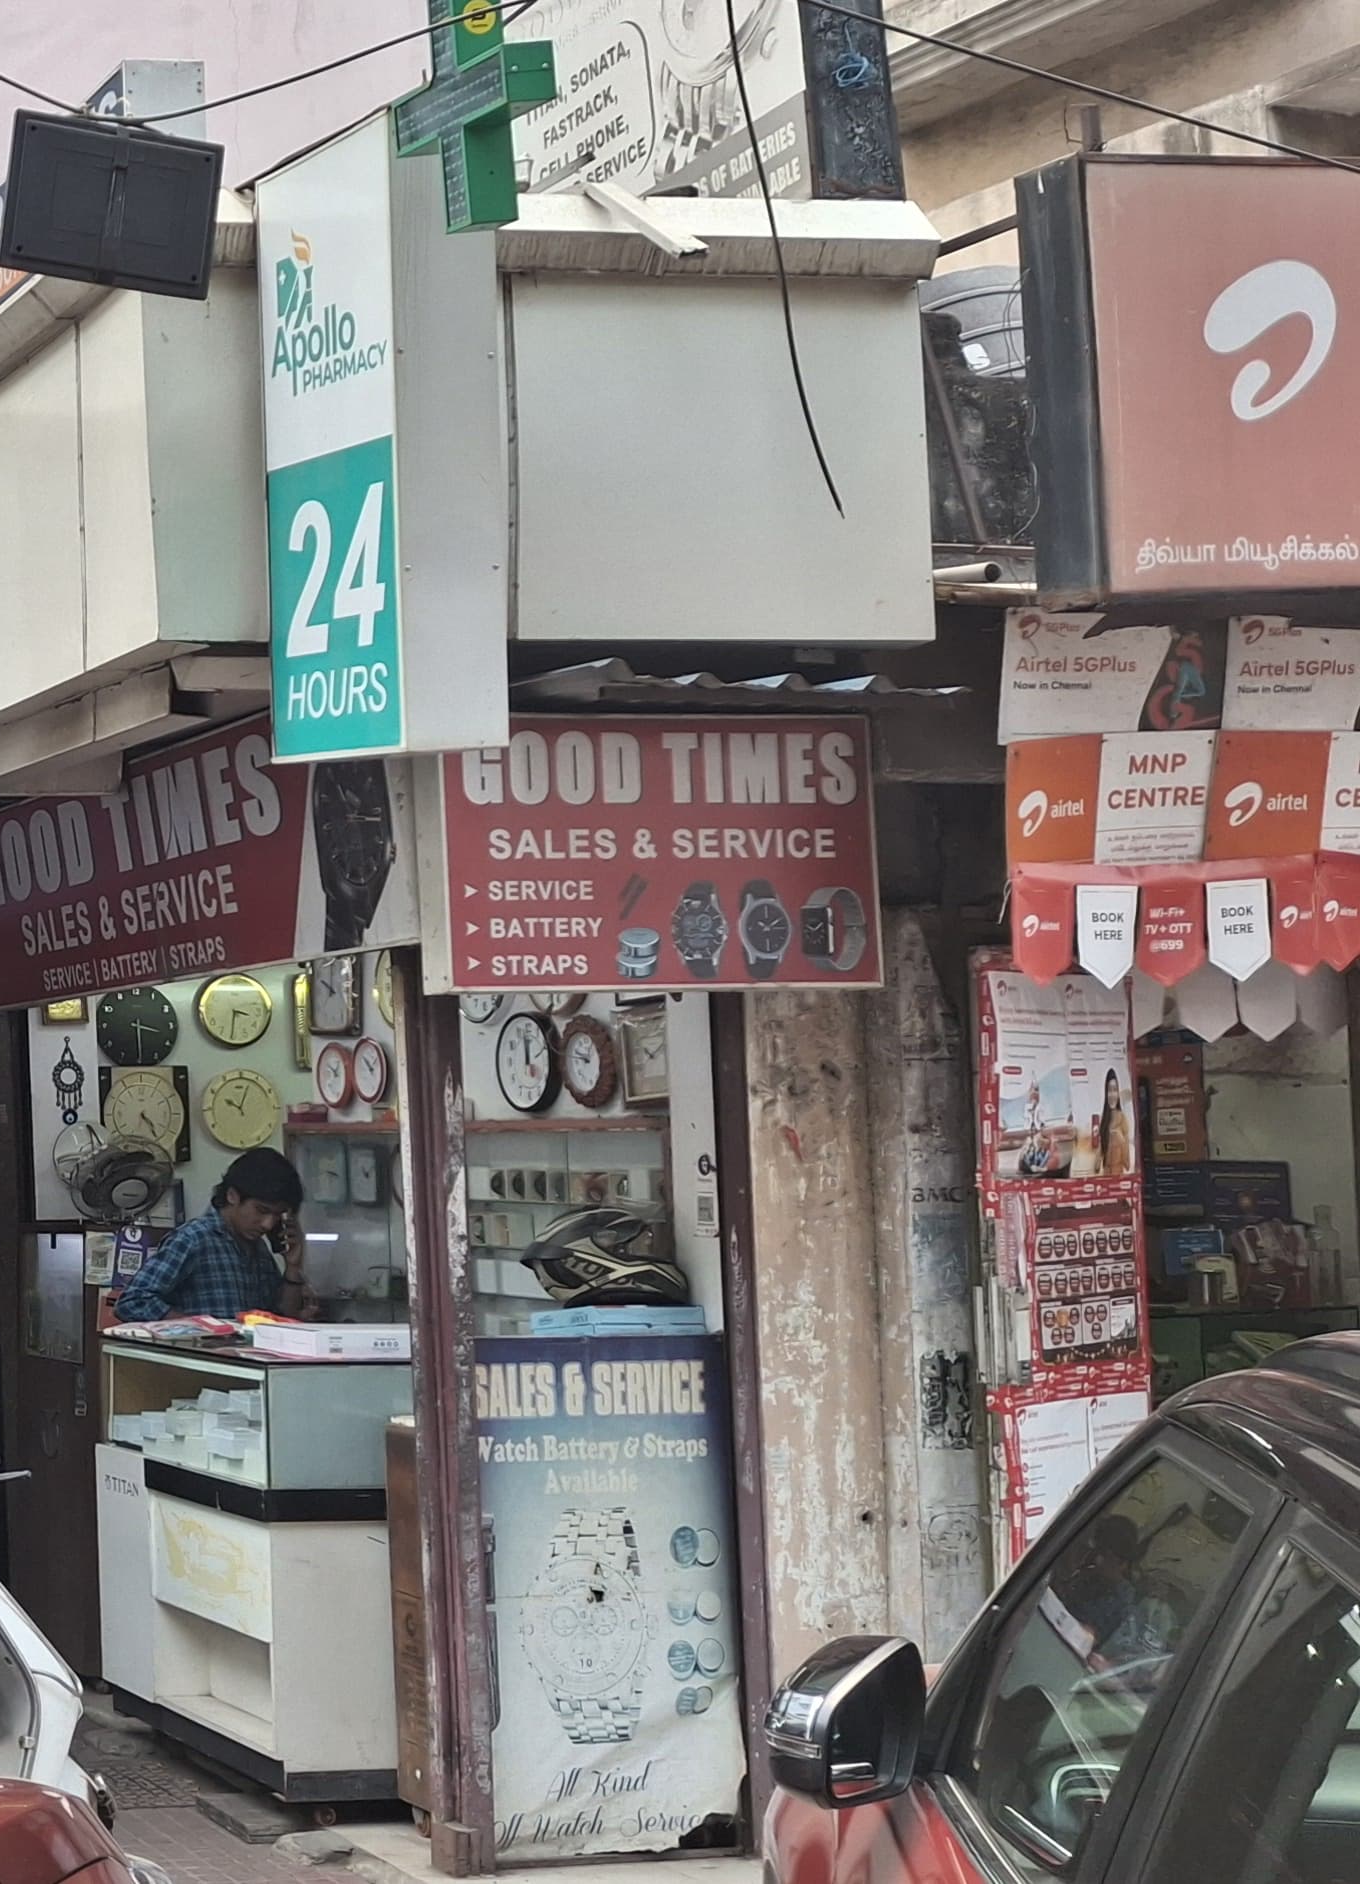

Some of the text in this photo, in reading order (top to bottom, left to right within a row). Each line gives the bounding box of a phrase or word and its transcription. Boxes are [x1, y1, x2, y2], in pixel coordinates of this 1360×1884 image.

[570, 40, 631, 93] SONATA,
[543, 84, 618, 150] FASTRACK,
[576, 114, 630, 160] PHONE,
[586, 136, 647, 183] SERVICE
[711, 164, 727, 192] OF
[271, 309, 356, 397] Apollo
[302, 338, 388, 395] PHARMACY
[286, 481, 386, 659] 24
[1016, 656, 1137, 673] Airtel 5GPlus
[1240, 659, 1355, 677] Airtel 5GPlus
[287, 662, 389, 722] HOURS
[1013, 681, 1037, 690] Now
[1051, 680, 1092, 690] Chennai
[1237, 685, 1260, 694] Now
[1273, 684, 1313, 694] Chennai
[462, 730, 858, 807] GOOD TIMES
[1128, 752, 1188, 776] MNP
[101, 734, 281, 872] TIMES
[1050, 798, 1085, 819] airtel
[1108, 785, 1206, 809] CENTRE
[1266, 793, 1308, 811] airtel
[488, 828, 837, 861] SALES & SERVICE
[488, 880, 594, 902] SERVICE
[21, 864, 239, 956] SALES & SERVICE
[1091, 912, 1125, 923] BOOK
[1221, 905, 1254, 918] BOOK
[489, 917, 604, 939] BATTERY
[1094, 930, 1123, 941] HERE
[1224, 923, 1254, 935] HERE
[43, 936, 226, 992] SERVICE BATTERY STRAPS
[491, 954, 588, 977] STRAPS
[475, 1359, 707, 1419] SALES & SERVICE
[542, 1434, 620, 1465] Battery
[623, 1436, 640, 1459] &
[642, 1432, 709, 1463] Straps
[111, 1476, 139, 1497] TITAN
[544, 1468, 639, 1495] Available
[545, 1760, 660, 1803] All Kind
[533, 1805, 605, 1845] Watch
[620, 1804, 701, 1838] Servic
